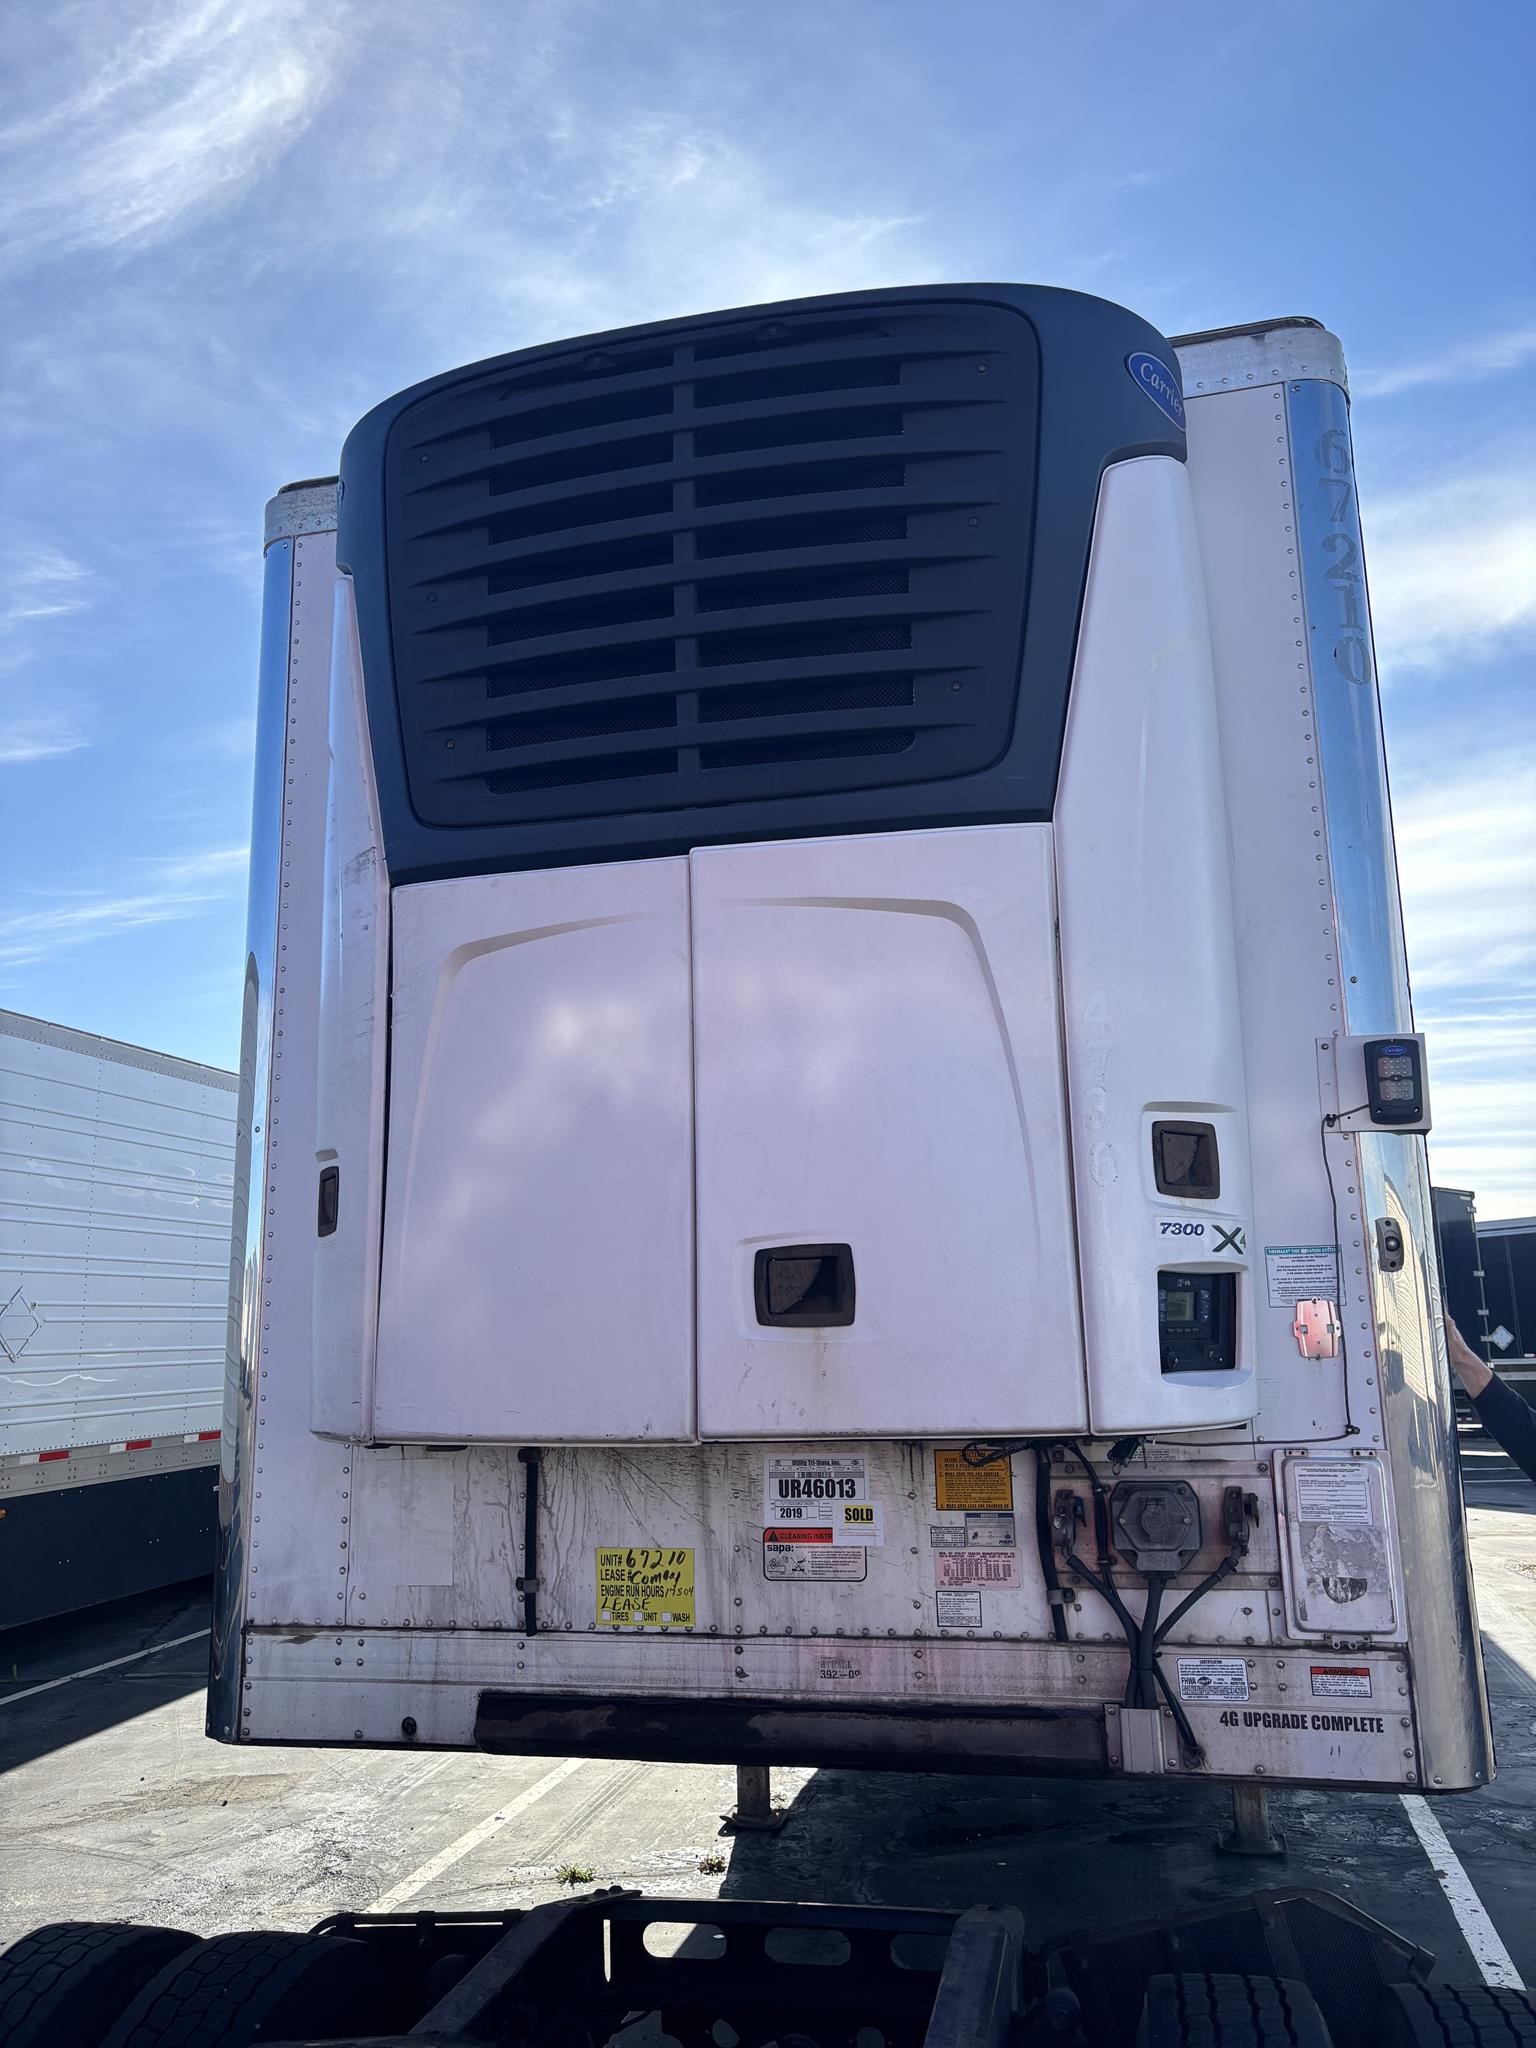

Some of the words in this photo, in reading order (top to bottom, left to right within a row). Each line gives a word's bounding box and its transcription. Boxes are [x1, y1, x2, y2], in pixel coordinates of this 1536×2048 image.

[1140, 363, 1184, 416] Carrier
[1314, 429, 1372, 685] 67210
[1160, 1222, 1205, 1236] 7300
[778, 1478, 856, 1499] UR46013
[779, 1507, 803, 1519] 2019
[844, 1508, 874, 1521] SOLD
[780, 1532, 812, 1540] CLEANING
[766, 1544, 794, 1554] sapa:
[600, 1554, 623, 1566] UNIT#
[625, 1548, 686, 1569] 67210
[600, 1569, 626, 1581] LEASE
[600, 1585, 625, 1597] ENGINE
[626, 1585, 640, 1597] RUN
[641, 1585, 665, 1598] HOURS
[601, 1597, 651, 1611] LEASE
[612, 1612, 629, 1622] TIRES
[643, 1612, 658, 1622] UNIT
[672, 1613, 691, 1622] WASH
[1219, 1711, 1239, 1727] 4G
[1243, 1712, 1309, 1730] UPGRADE
[1311, 1714, 1385, 1734] COMPLETE
